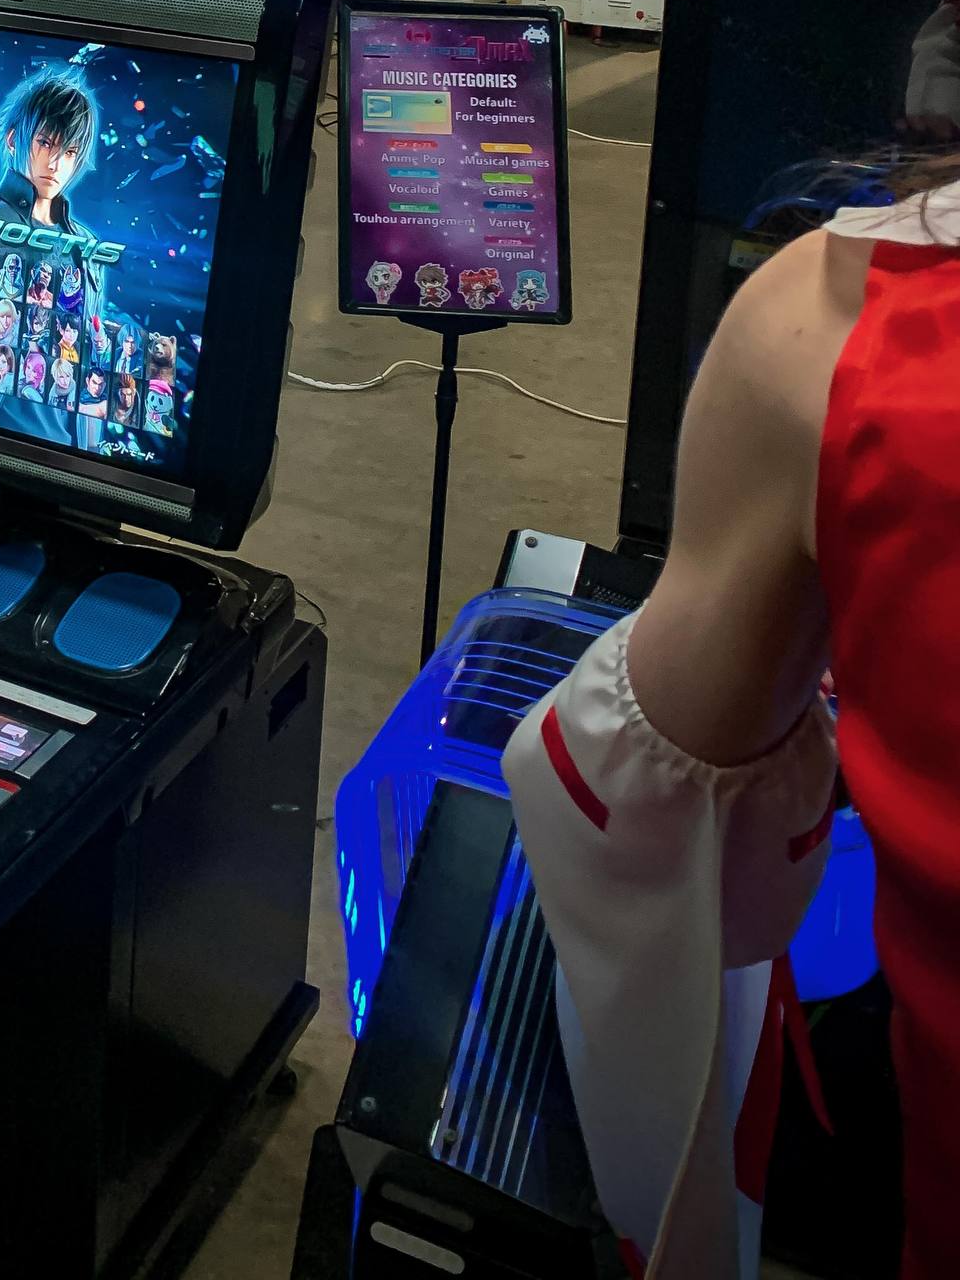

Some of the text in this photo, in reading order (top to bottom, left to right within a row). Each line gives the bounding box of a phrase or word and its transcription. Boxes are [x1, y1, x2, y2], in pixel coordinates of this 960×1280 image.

[382, 70, 518, 90] MUSIC CATEGORIES
[469, 96, 518, 108] Default:
[455, 111, 536, 125] For beginners
[381, 152, 446, 166] Anime Pop
[465, 155, 550, 169] Musical games
[388, 183, 441, 195] Vocaloid
[488, 186, 529, 198] Games
[353, 212, 476, 228] Touhou arrangement
[488, 217, 531, 231] Variety
[485, 248, 535, 262] Original
